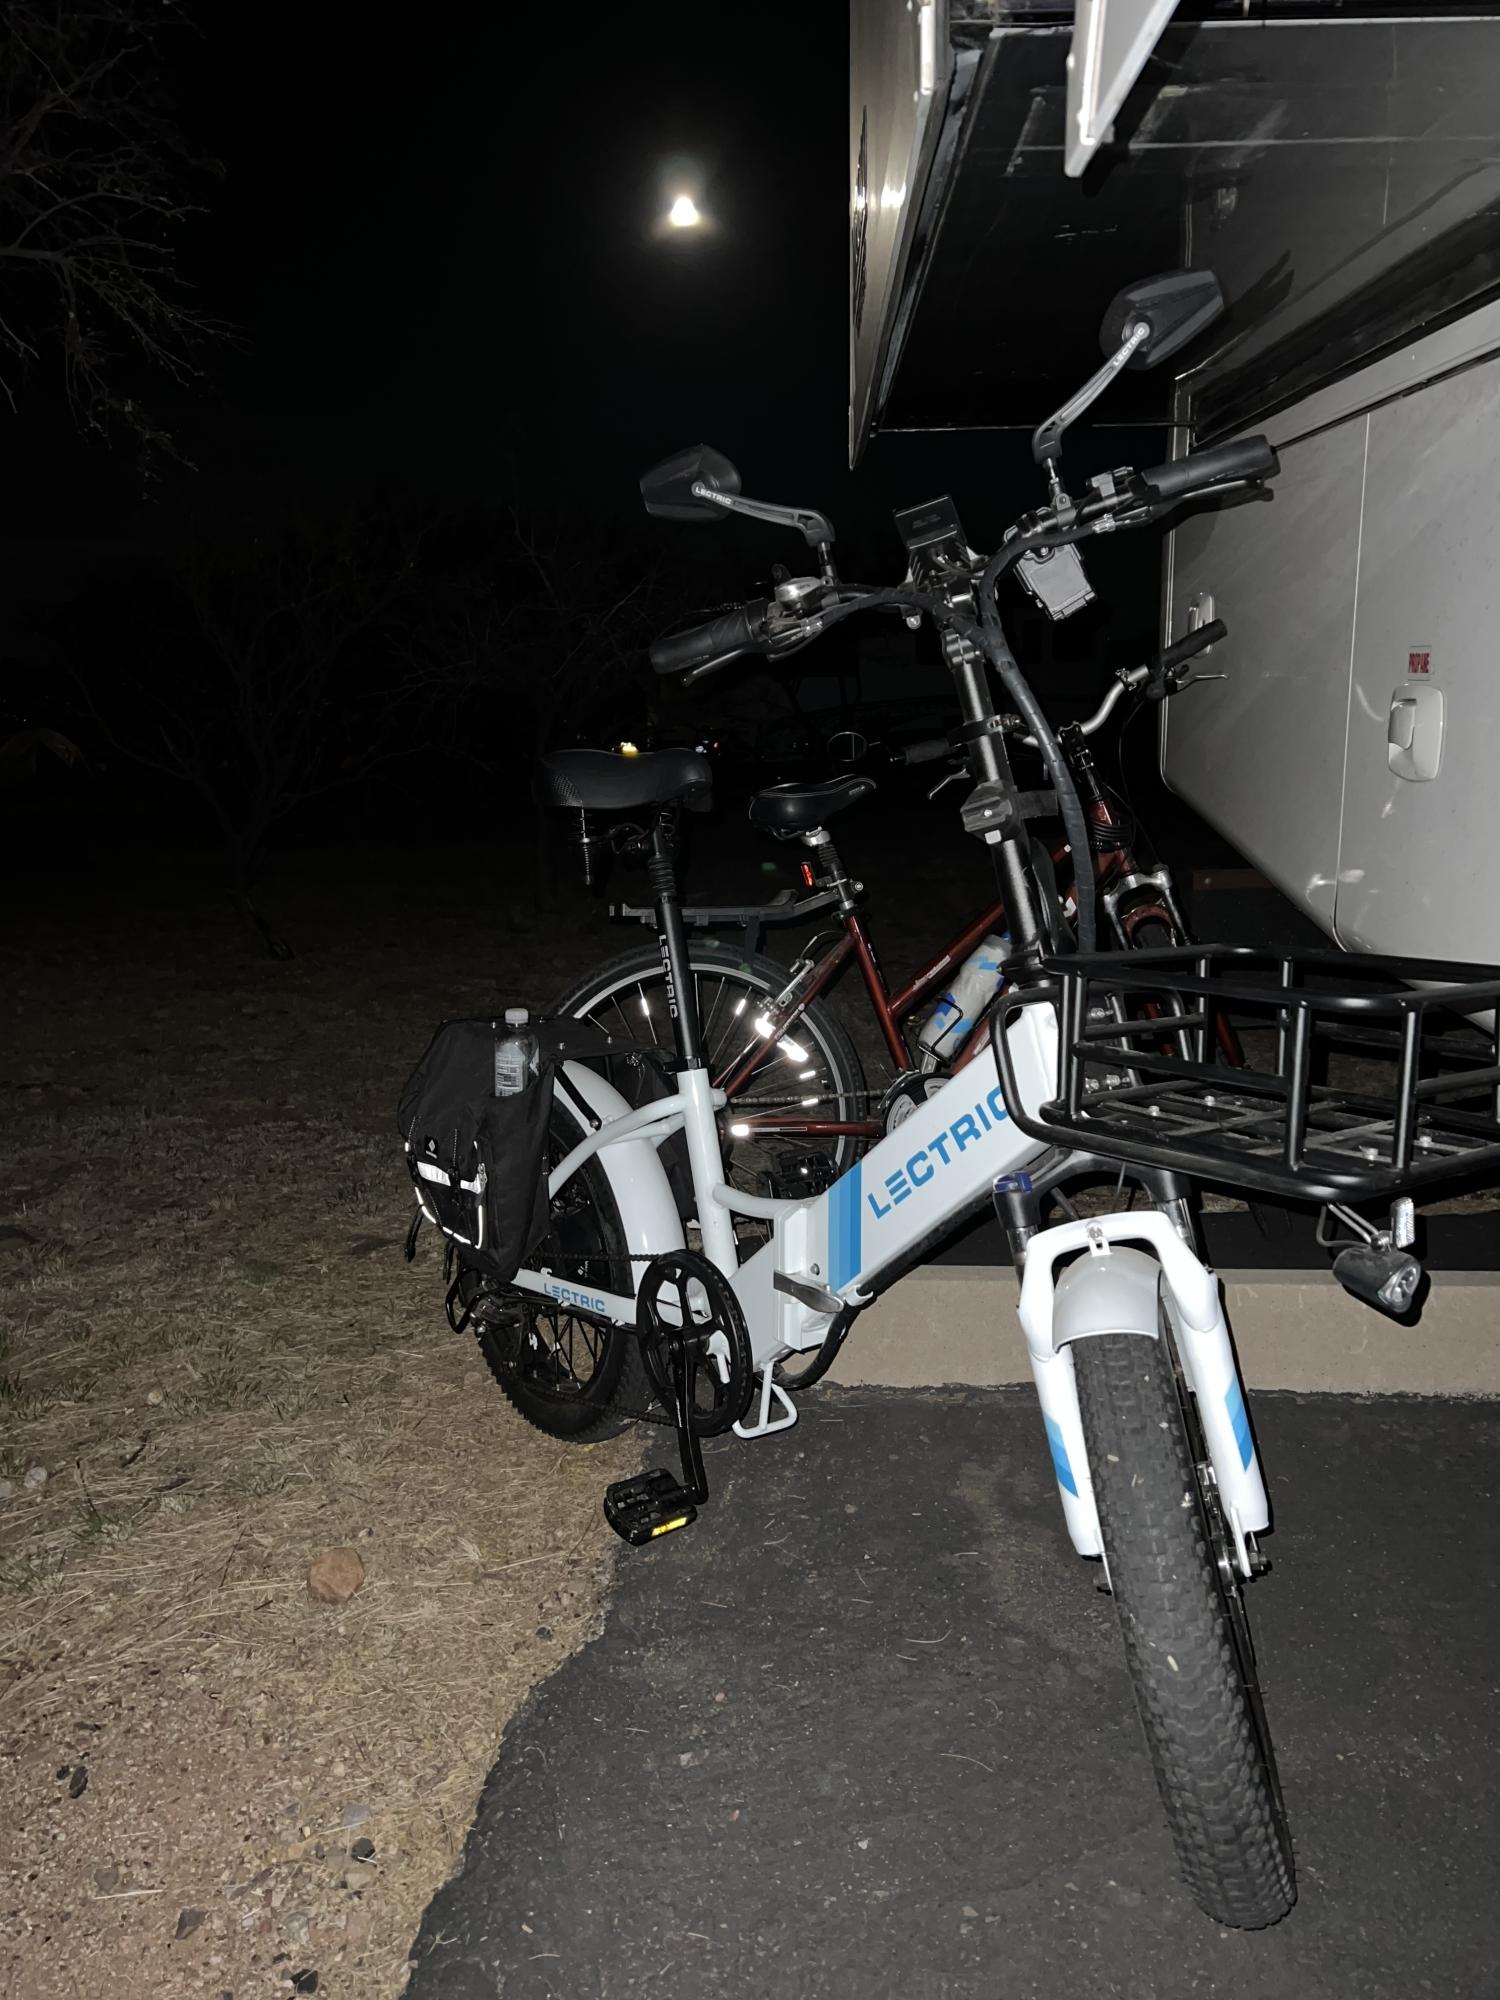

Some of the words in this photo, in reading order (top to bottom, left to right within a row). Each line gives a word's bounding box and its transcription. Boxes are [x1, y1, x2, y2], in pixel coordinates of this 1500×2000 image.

[695, 486, 732, 505] LECTRIC
[659, 934, 678, 1018] LECTRIC
[867, 1085, 1008, 1219] LECTRIC
[543, 1282, 606, 1313] LECTRIC
